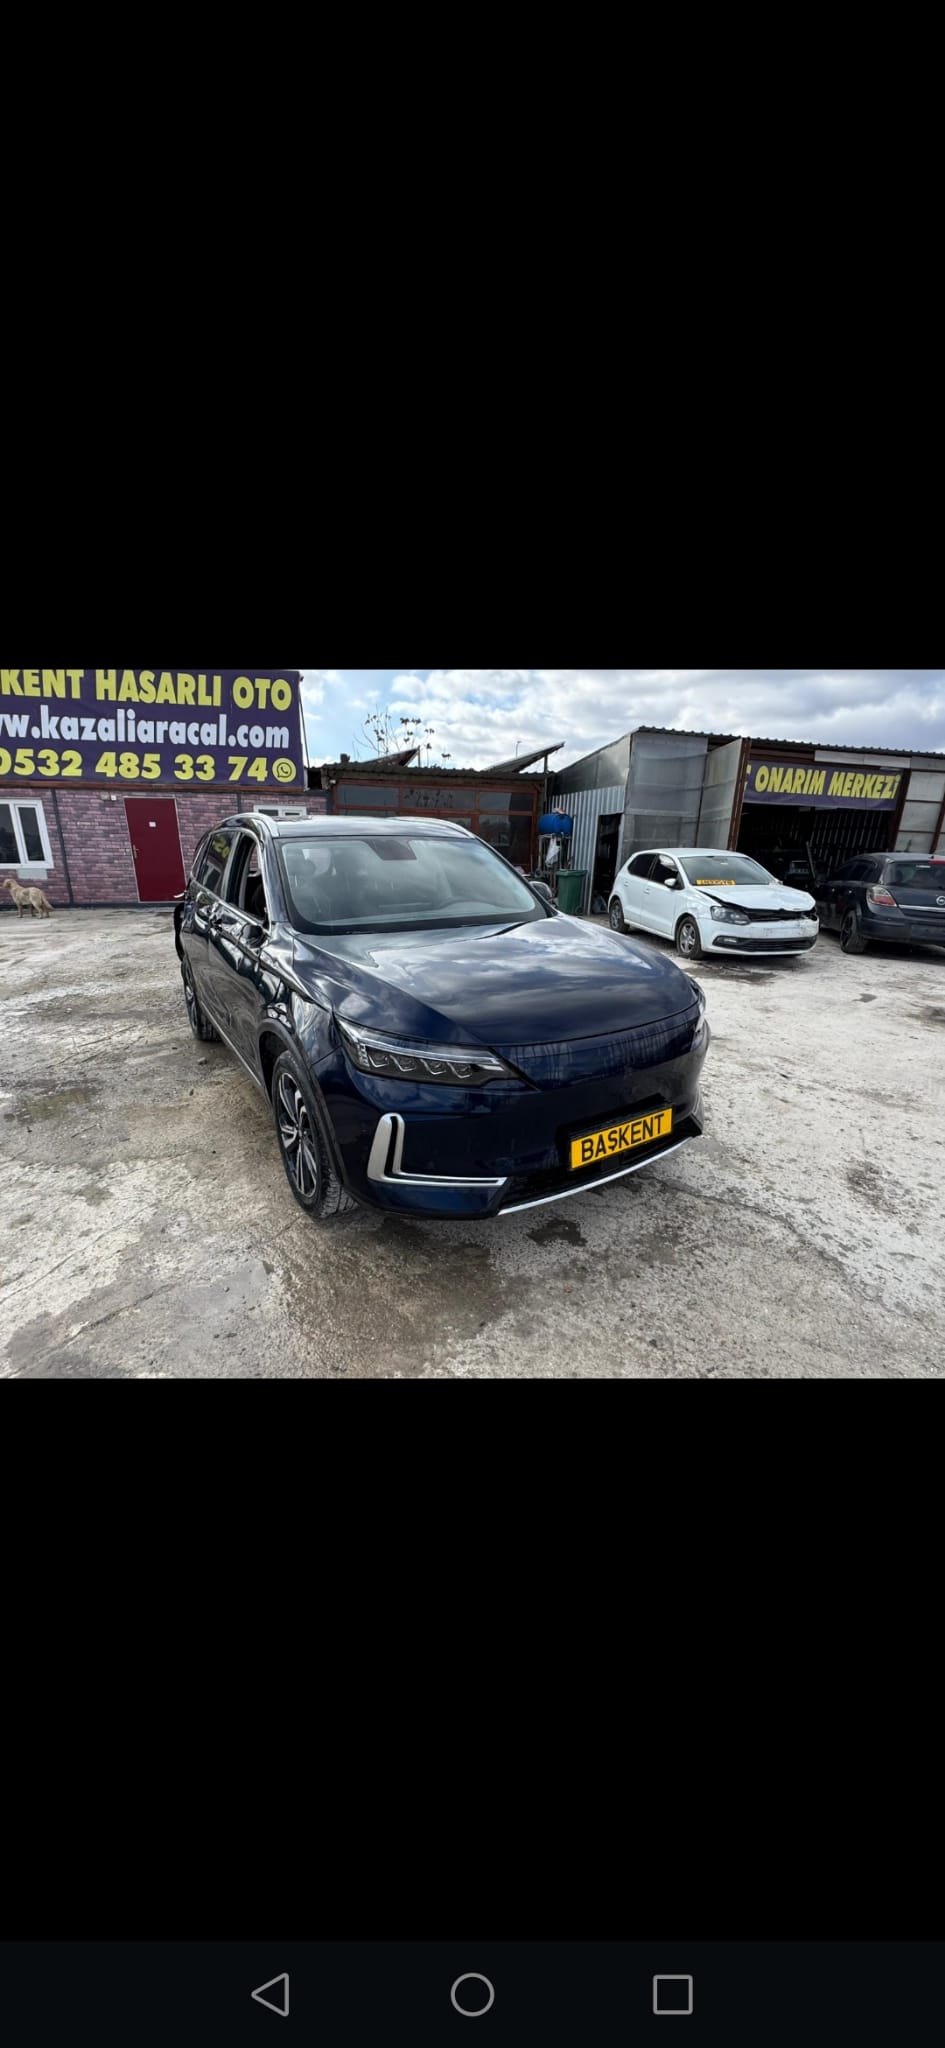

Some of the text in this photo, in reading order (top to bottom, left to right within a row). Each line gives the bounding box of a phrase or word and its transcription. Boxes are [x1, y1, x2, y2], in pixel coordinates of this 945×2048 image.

[1, 669, 292, 711] KENT HASARLI OTO
[0, 704, 289, 748] w.kazaliaracal.com
[95, 751, 161, 779] 485
[174, 754, 215, 781] 33
[228, 756, 268, 782] 74
[755, 765, 826, 795] ONARIM
[827, 771, 901, 799] MERKEZİ
[581, 1113, 665, 1163] BAŞKENT
